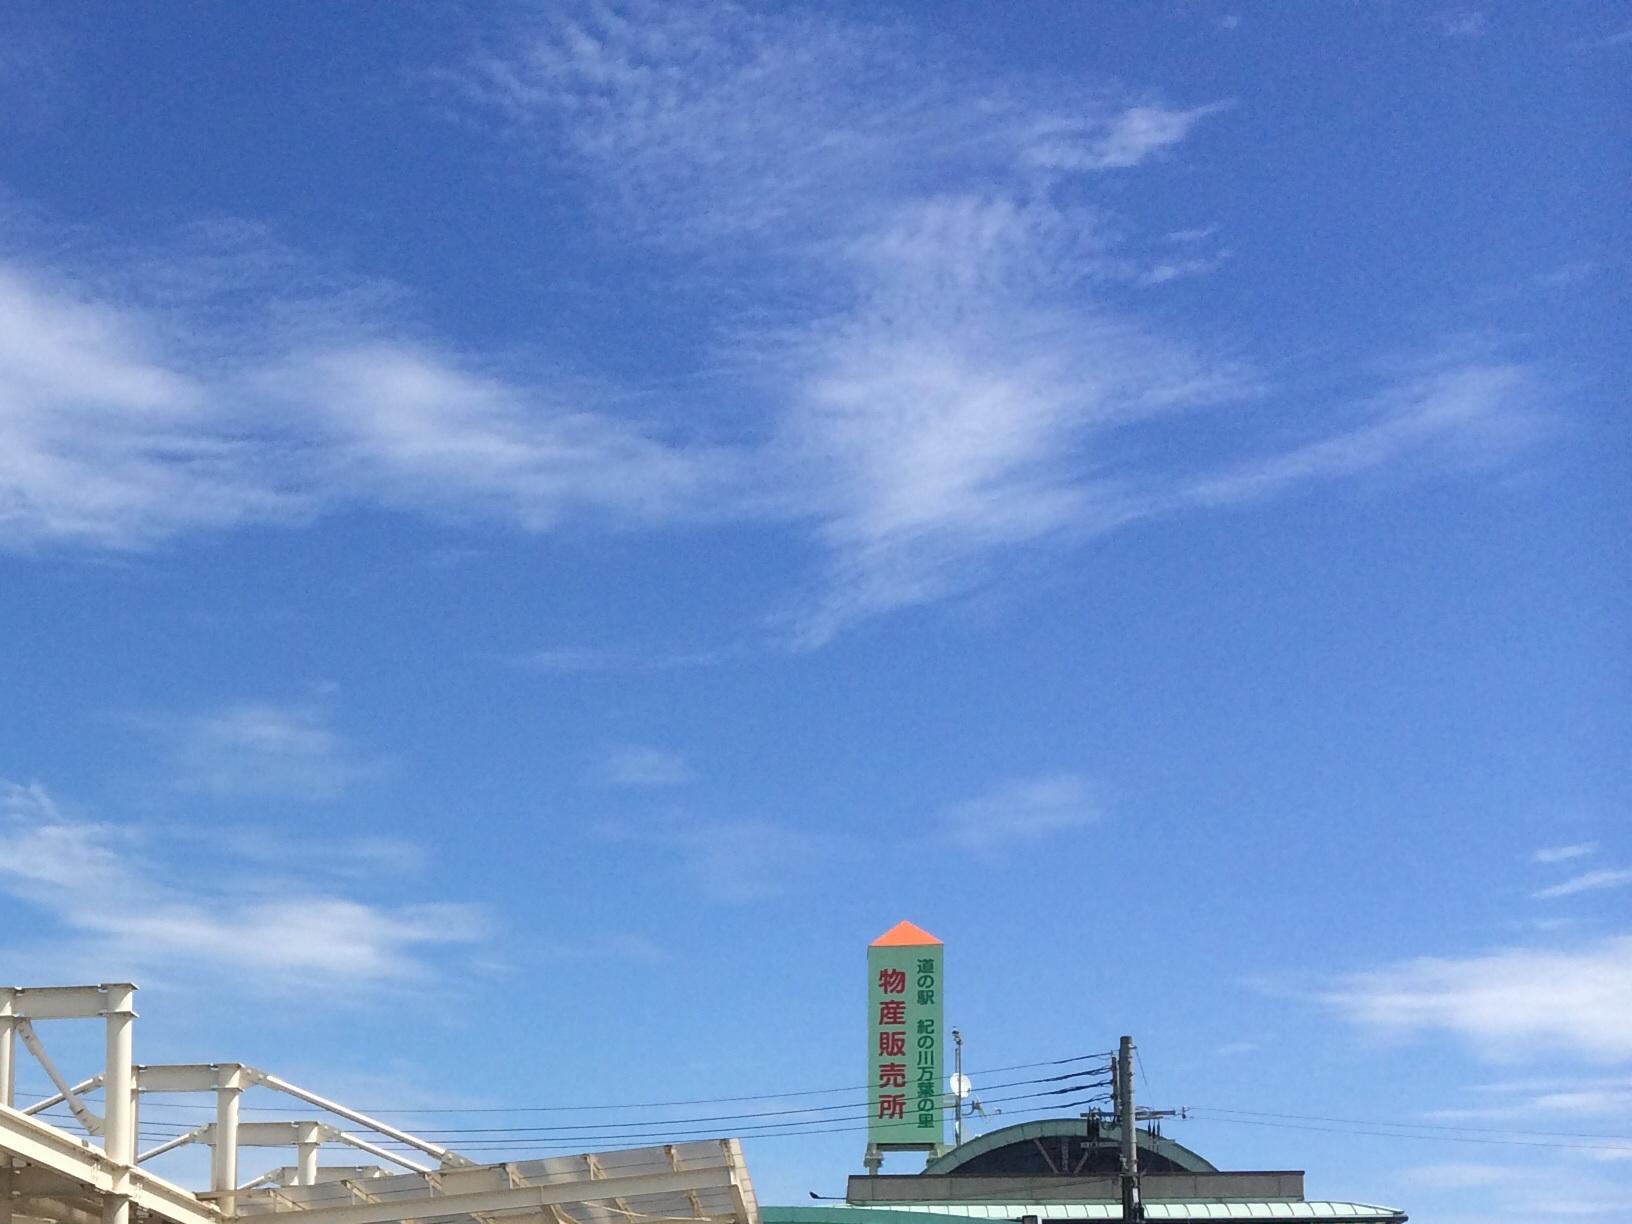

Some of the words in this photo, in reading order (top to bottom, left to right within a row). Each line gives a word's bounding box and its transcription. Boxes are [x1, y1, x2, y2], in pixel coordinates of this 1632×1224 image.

[916, 958, 935, 1005] 道の駅
[878, 968, 907, 1120] 物産販売所
[916, 1019, 935, 1129] 紀の川万葉の里
